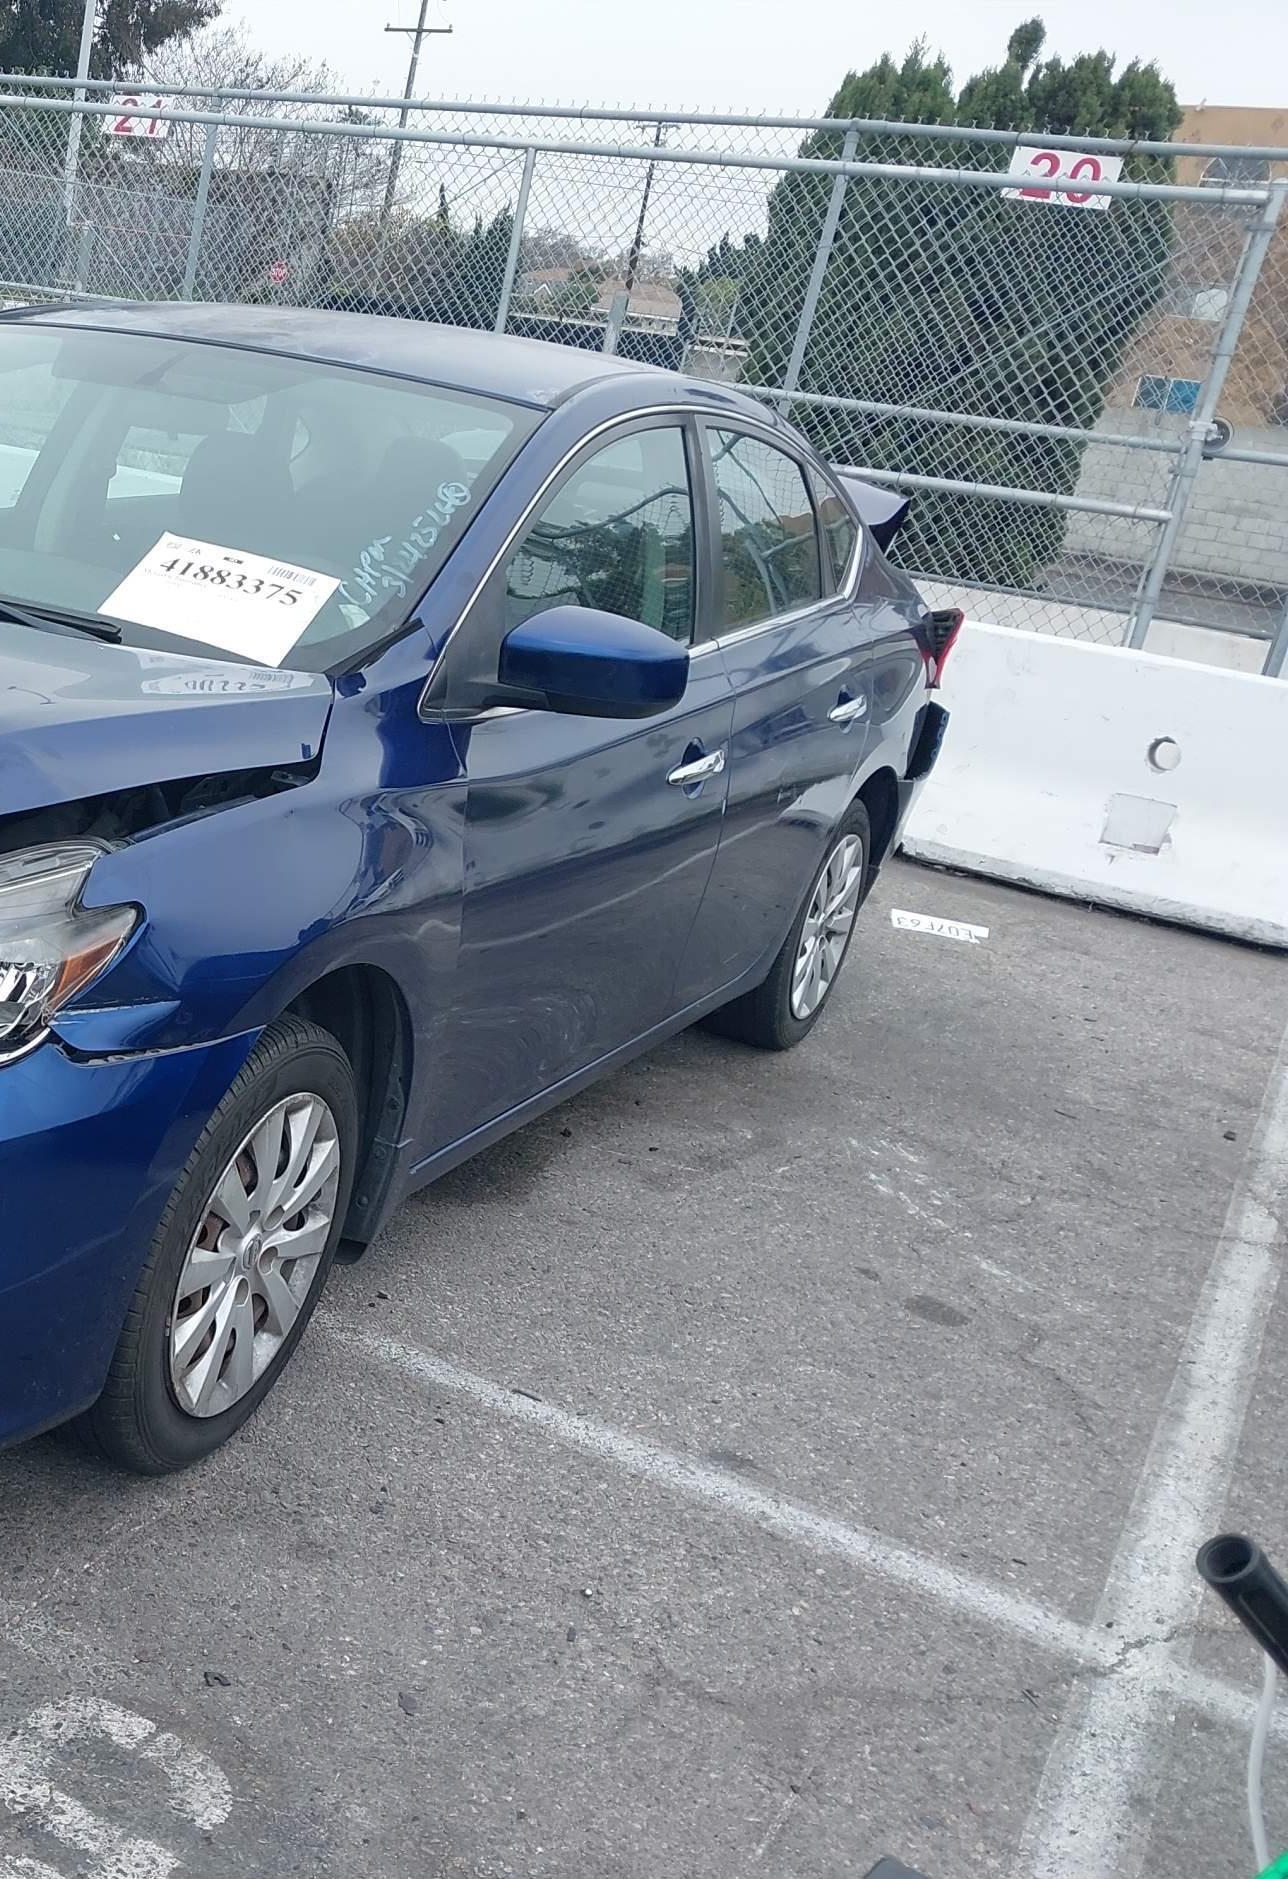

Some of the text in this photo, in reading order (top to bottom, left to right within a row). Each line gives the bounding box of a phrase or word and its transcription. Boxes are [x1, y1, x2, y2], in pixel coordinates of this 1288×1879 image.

[114, 98, 163, 135] 21
[1020, 152, 1102, 204] 20
[160, 558, 304, 606] 41883375
